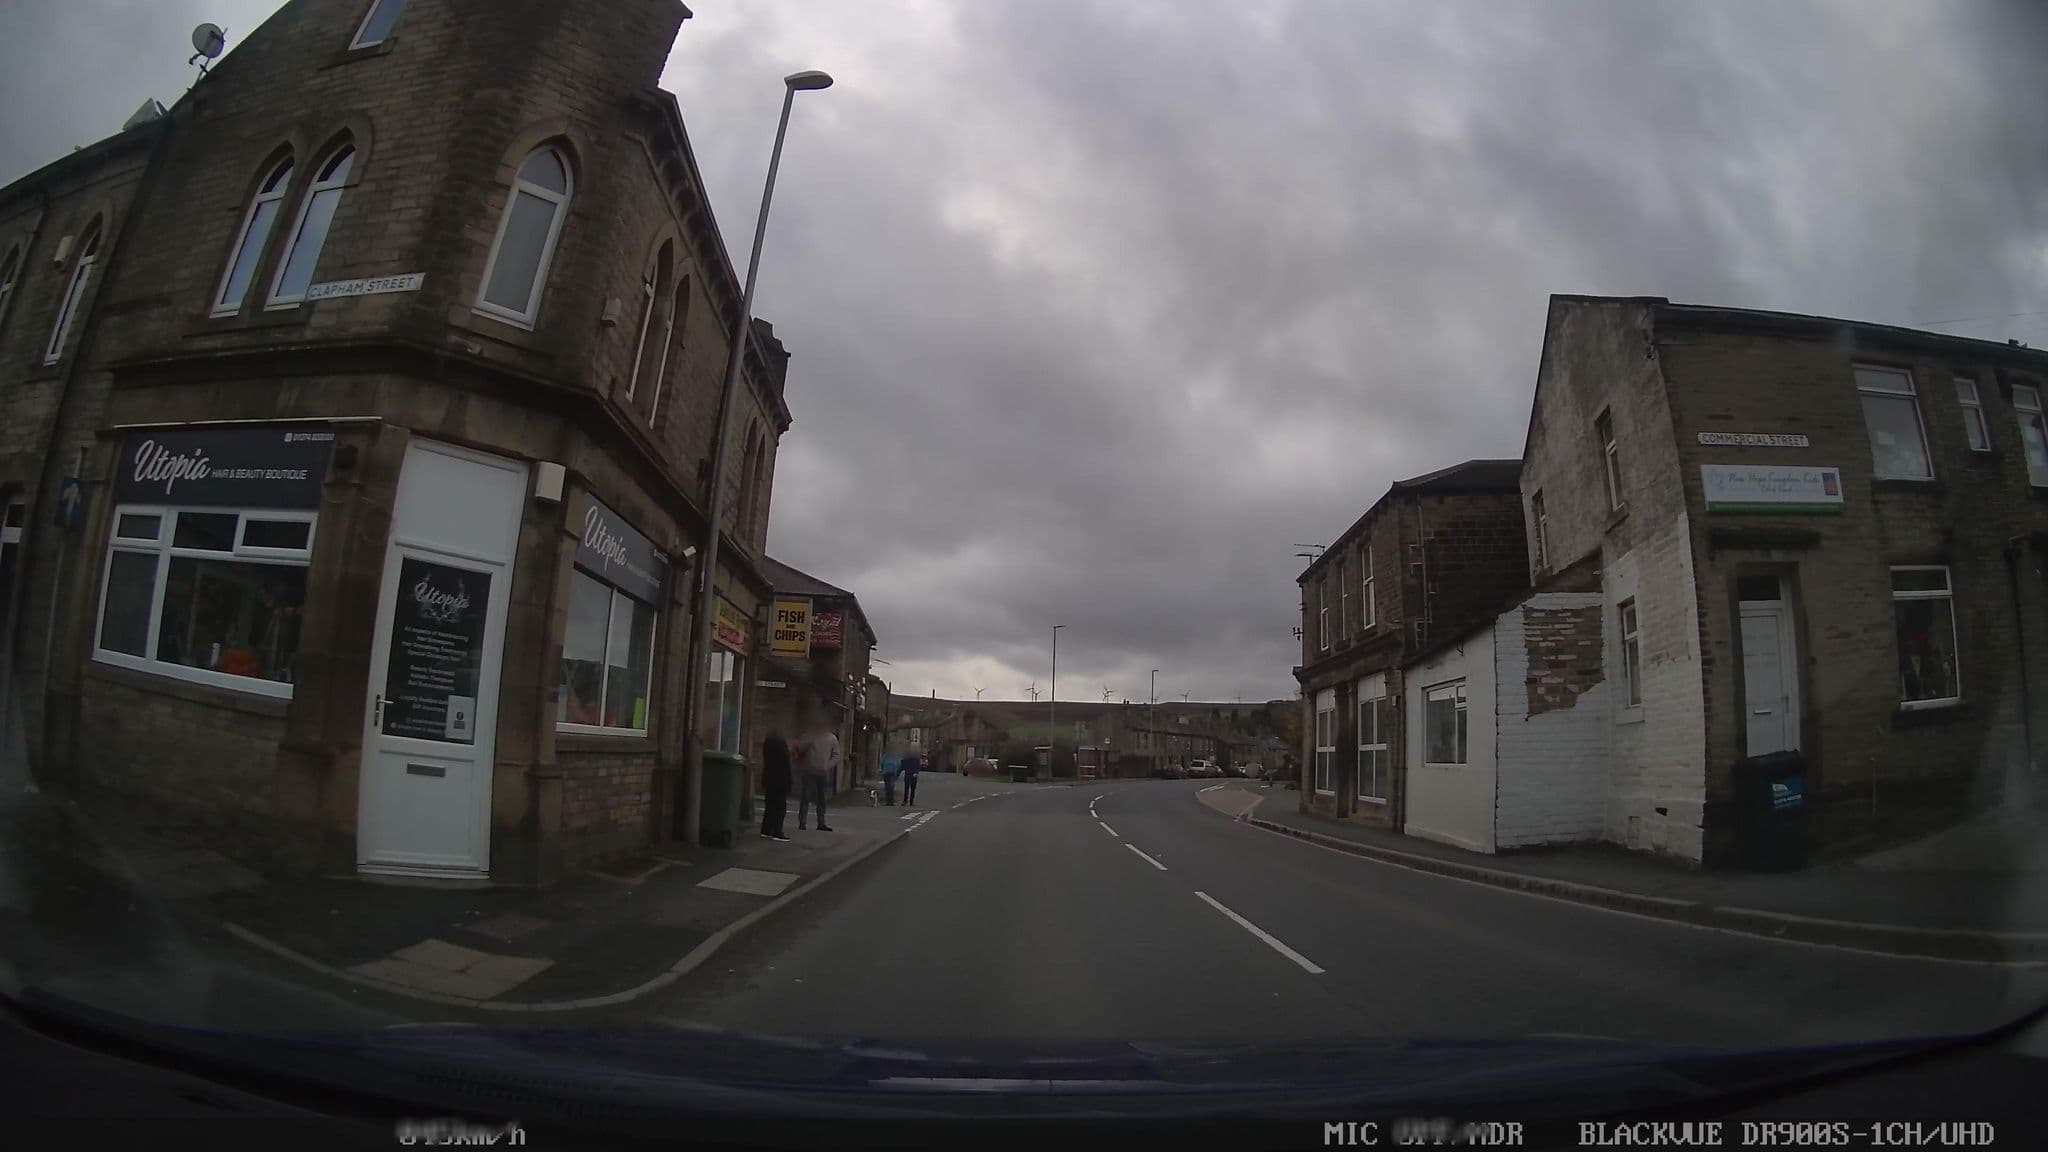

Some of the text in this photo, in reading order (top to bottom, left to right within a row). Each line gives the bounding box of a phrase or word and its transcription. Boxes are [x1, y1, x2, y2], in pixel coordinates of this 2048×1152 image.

[310, 277, 414, 297] CLAPHAM STREET
[1703, 433, 1805, 446] COMMERCIAL STREET
[134, 439, 210, 495] Utopia
[212, 469, 229, 479] HAIR
[235, 469, 265, 479] BEAUTY
[265, 469, 308, 480] BOUTIQUE
[585, 505, 627, 572] Utopia
[414, 582, 470, 611] Utopia
[778, 610, 805, 623] FISH
[775, 630, 805, 642] CHIPS
